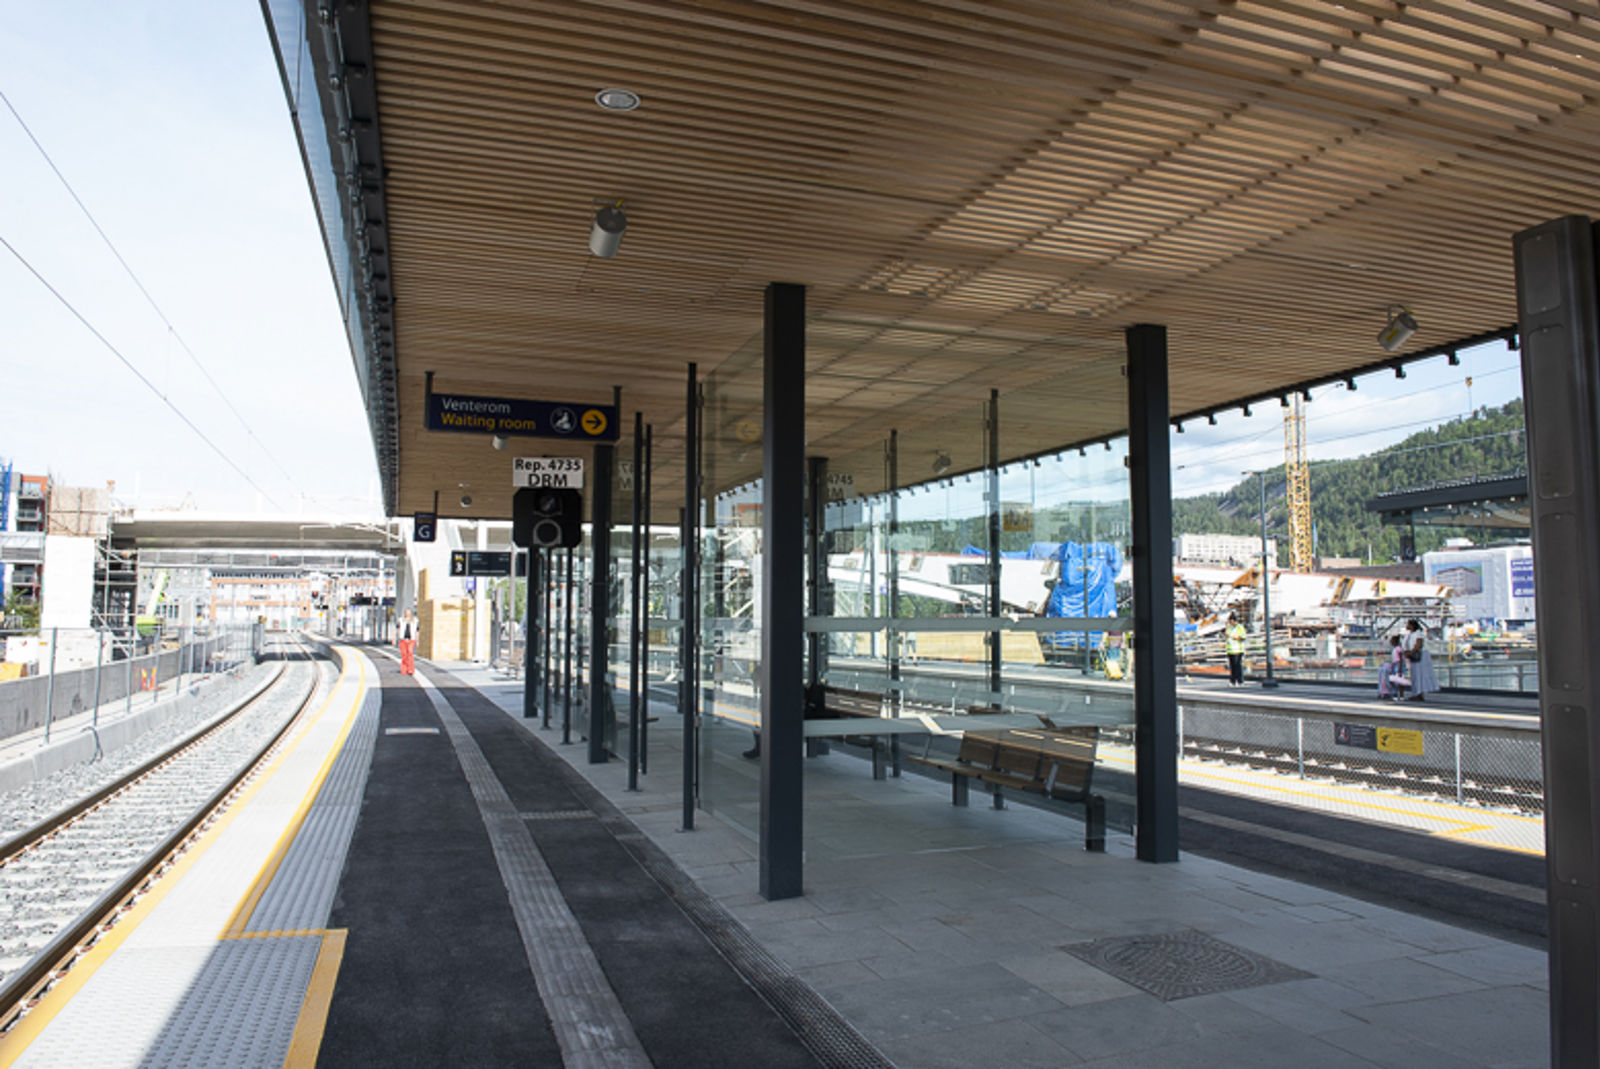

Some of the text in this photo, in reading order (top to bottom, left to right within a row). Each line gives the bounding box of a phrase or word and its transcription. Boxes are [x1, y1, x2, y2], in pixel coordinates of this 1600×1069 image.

[442, 397, 511, 414] Venterom
[441, 411, 536, 430] Waiting room
[515, 459, 582, 473] Rep. 4735
[528, 473, 568, 488] DRM
[418, 525, 430, 540] G
